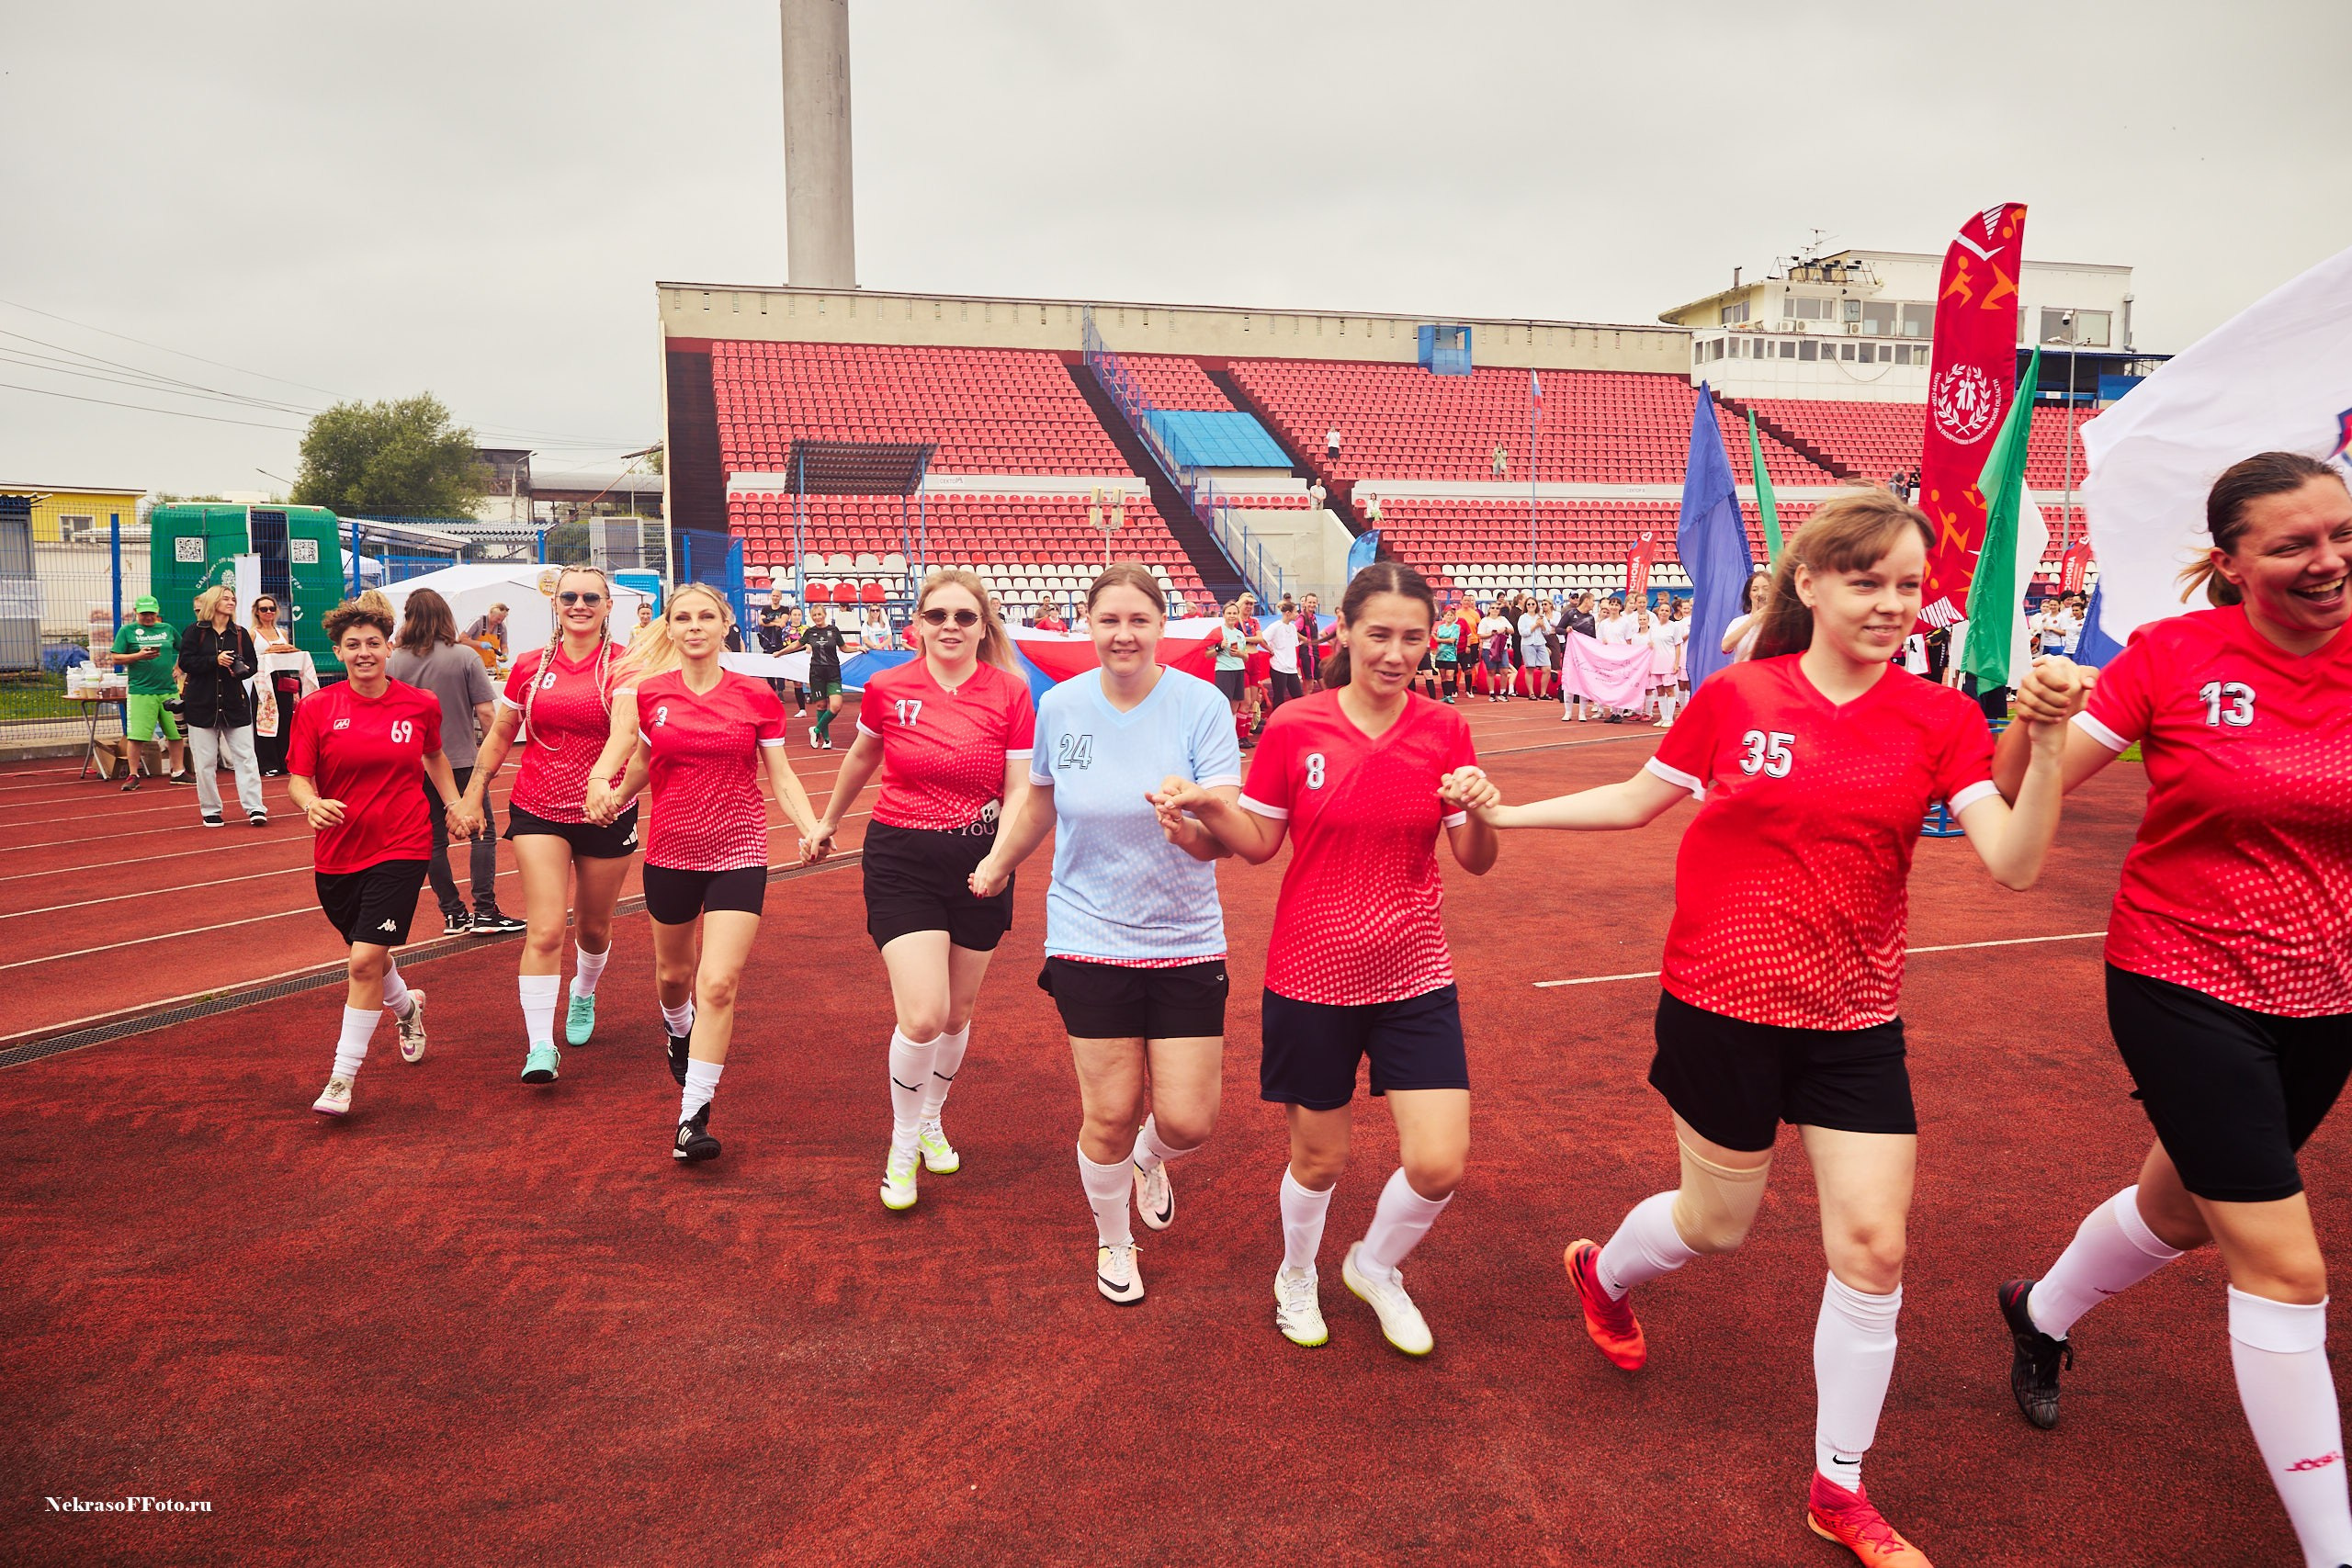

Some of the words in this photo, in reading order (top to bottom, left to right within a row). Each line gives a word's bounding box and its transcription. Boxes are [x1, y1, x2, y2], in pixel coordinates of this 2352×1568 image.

[530, 671, 557, 690] 8
[655, 705, 668, 727] 3
[894, 698, 922, 727] 17
[2199, 680, 2256, 727] 13
[390, 720, 413, 743] 69
[1057, 733, 1093, 770] 24
[1739, 729, 1795, 779] 35
[1306, 752, 1325, 790] 8
